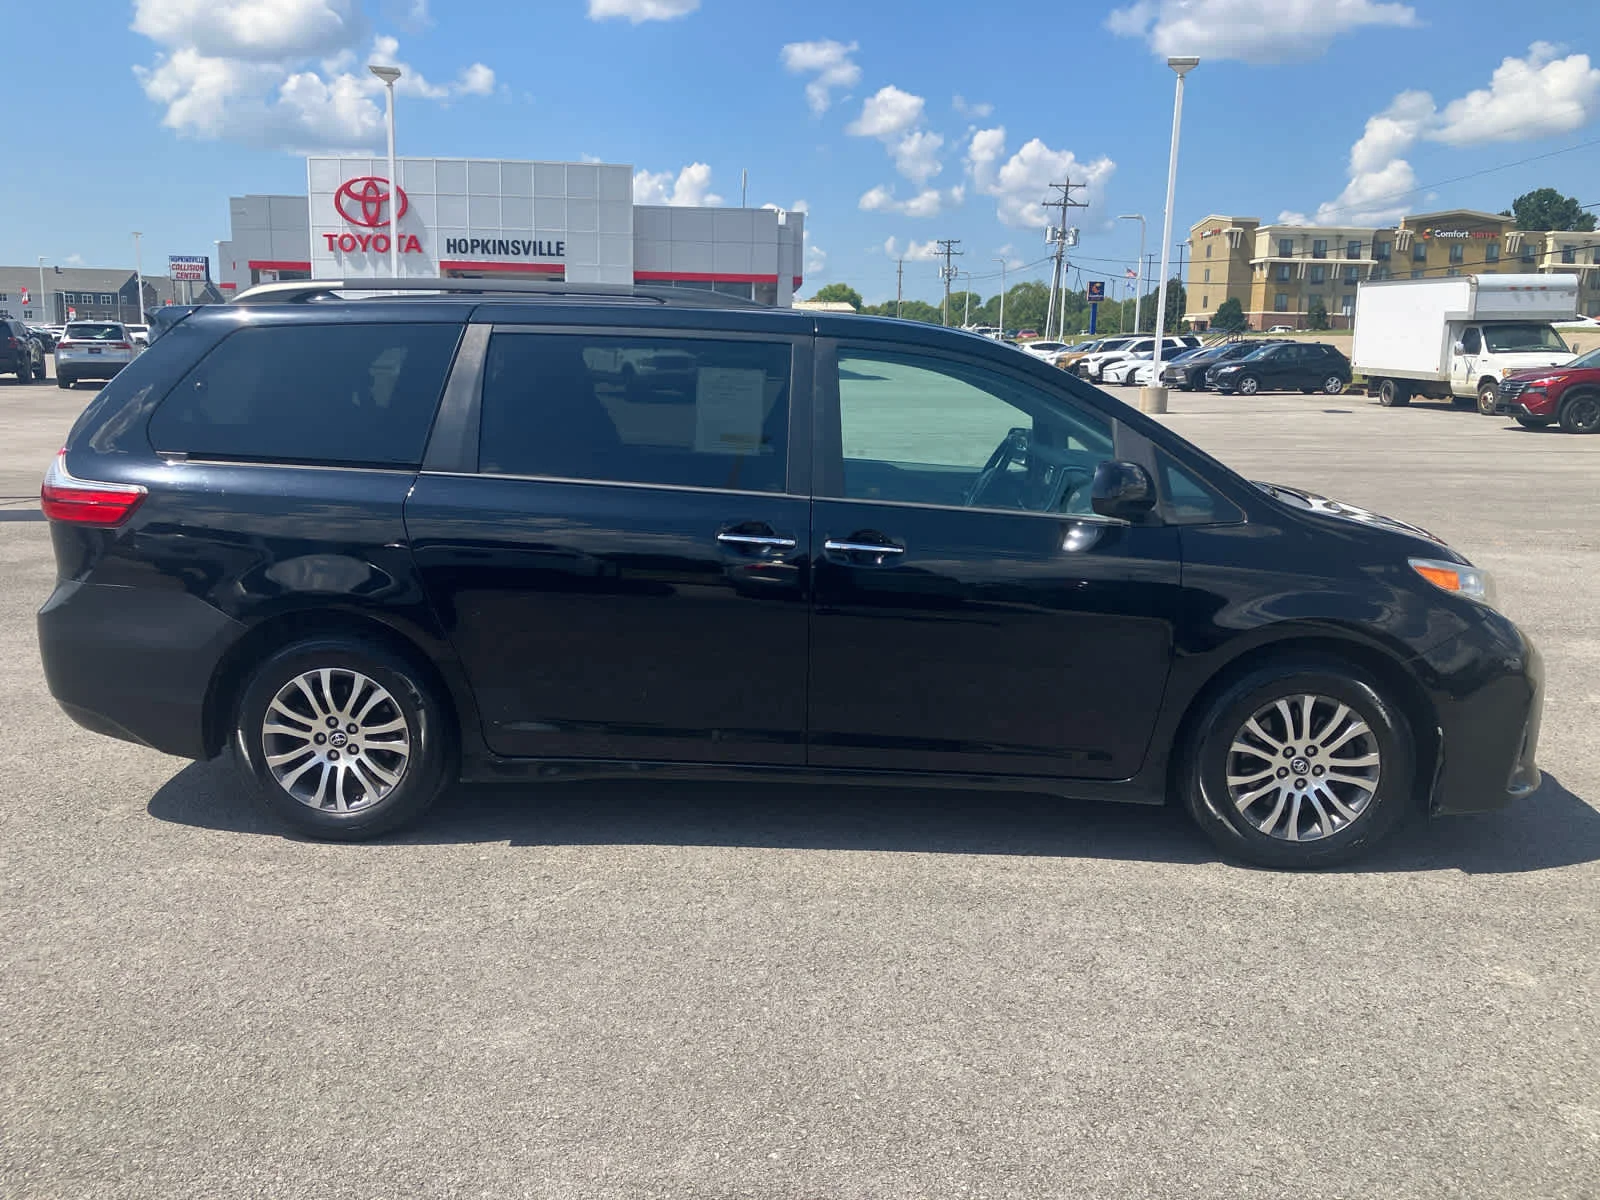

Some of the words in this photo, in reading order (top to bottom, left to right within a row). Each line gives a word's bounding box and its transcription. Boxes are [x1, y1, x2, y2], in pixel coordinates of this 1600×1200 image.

[1434, 229, 1469, 238] Comfort
[322, 233, 423, 253] TOYOTA
[446, 238, 565, 256] HOPKINSVILLE
[171, 264, 205, 272] COLLISION
